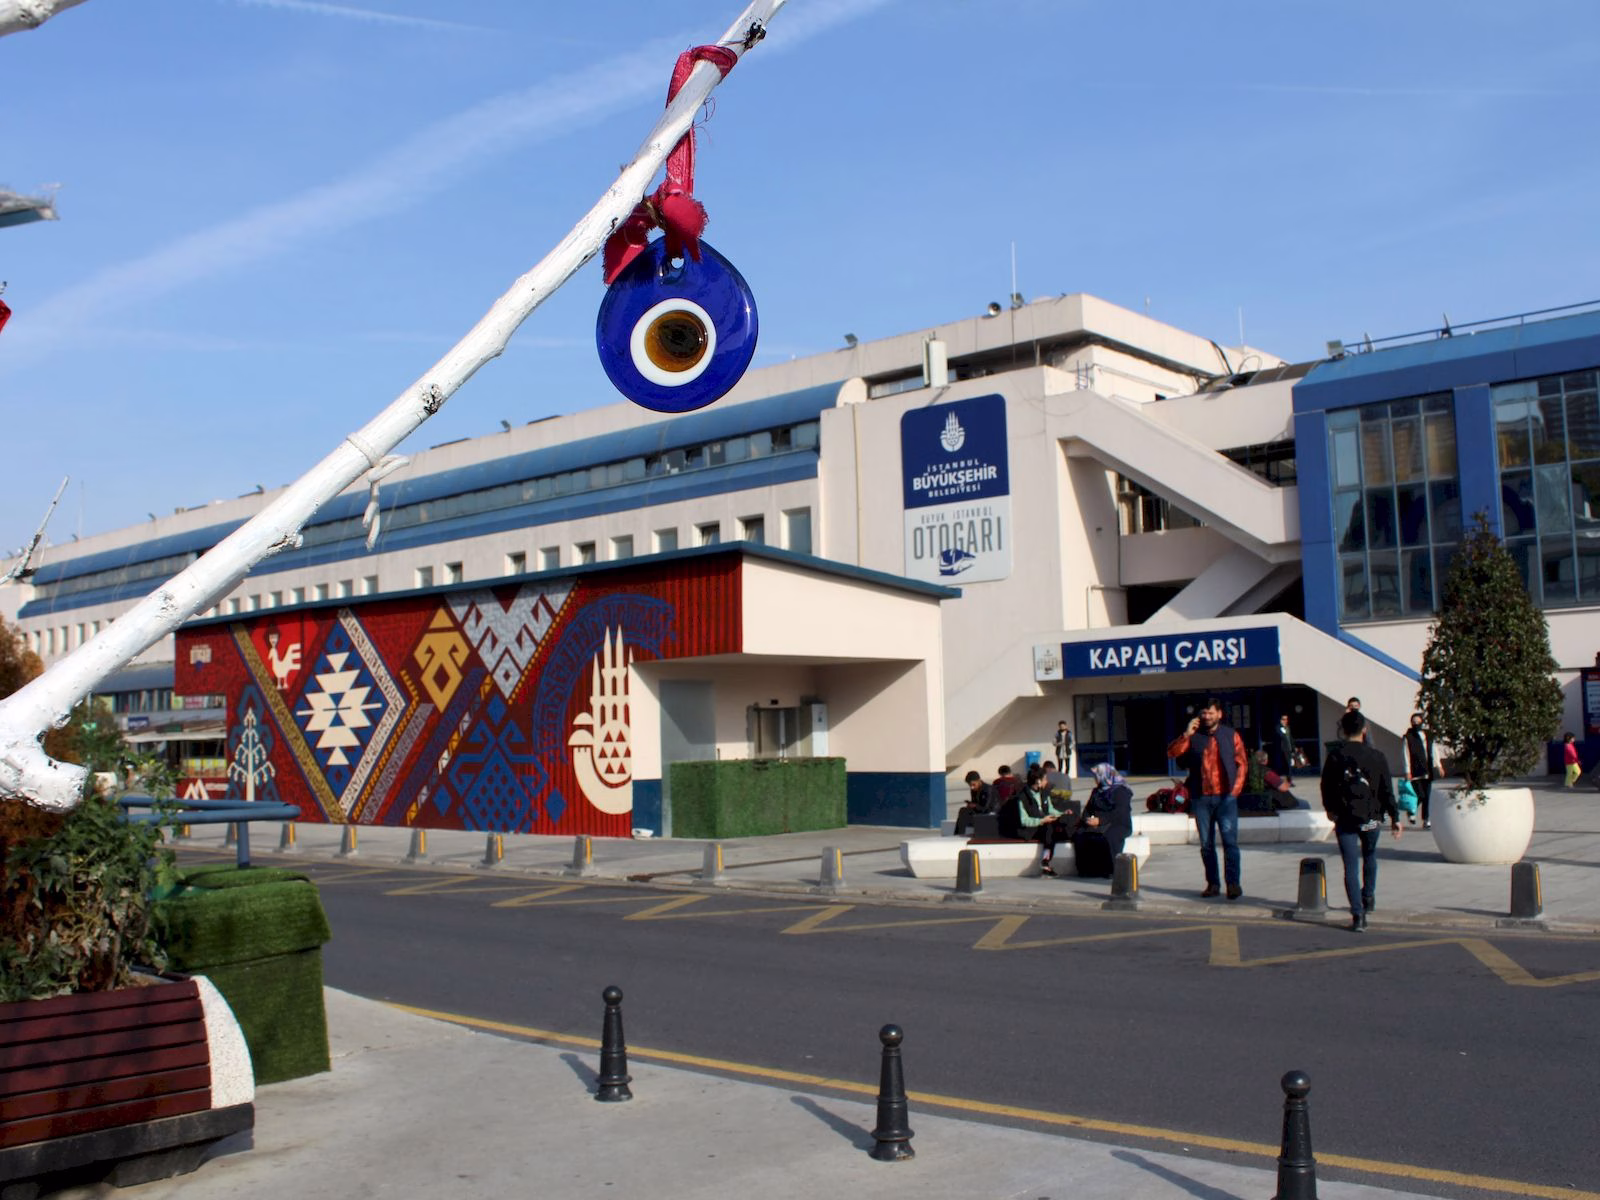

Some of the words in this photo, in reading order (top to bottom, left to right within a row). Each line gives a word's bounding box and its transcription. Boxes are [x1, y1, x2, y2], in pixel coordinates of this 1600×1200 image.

[913, 464, 997, 491] BÜYÜKŞEHİR
[927, 459, 980, 473] İSTANBUL
[928, 483, 981, 498] BELEDİYESİ
[914, 516, 1002, 560] OTOGARI
[1089, 643, 1167, 669] KAPALI
[1175, 638, 1246, 668] ÇARŞI
